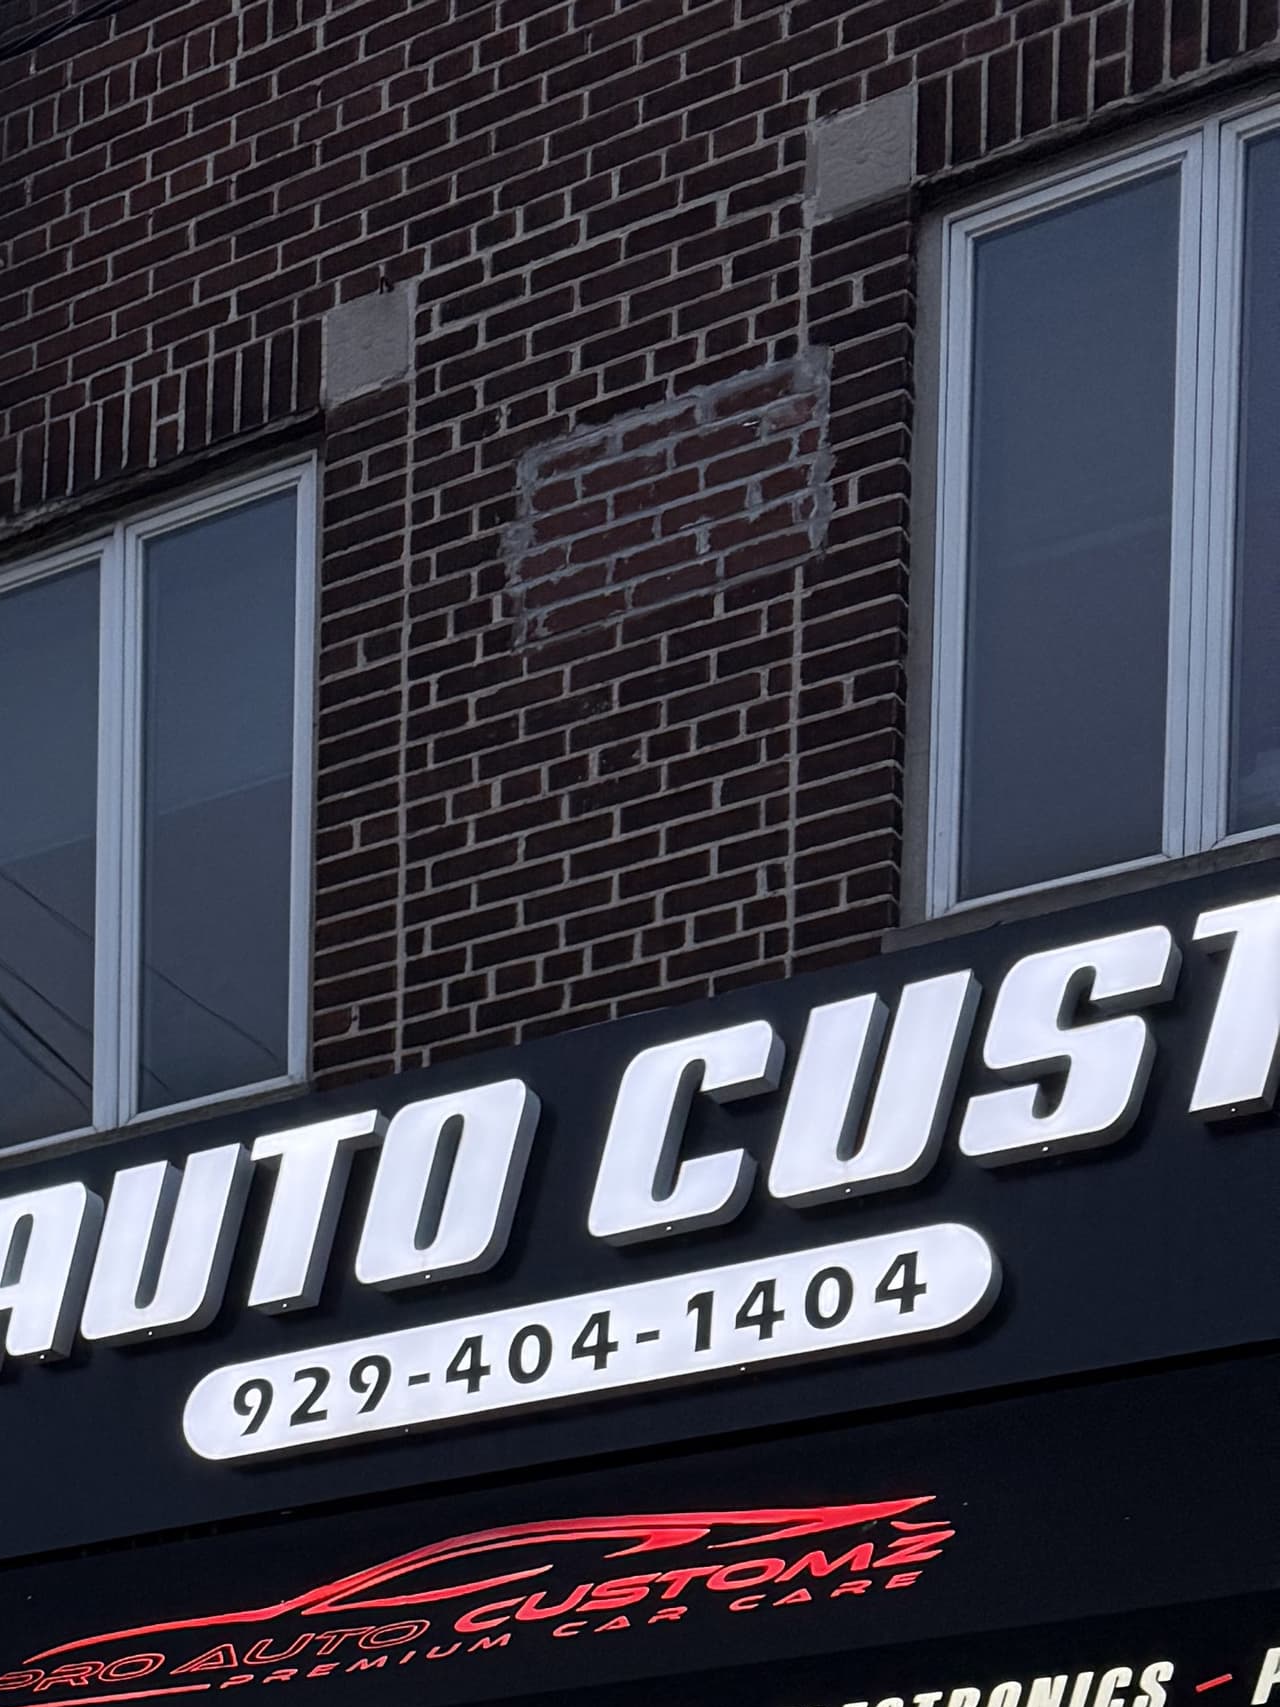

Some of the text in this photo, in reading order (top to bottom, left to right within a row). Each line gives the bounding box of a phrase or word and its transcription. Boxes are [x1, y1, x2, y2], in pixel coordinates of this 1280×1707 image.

[588, 895, 1280, 1246] CUST
[232, 1250, 929, 1437] 929-404-1404
[169, 1619, 432, 1676] AUTO
[452, 1528, 957, 1634] CUSTOMZ
[218, 1571, 924, 1690] PREMIUM CAR CARE
